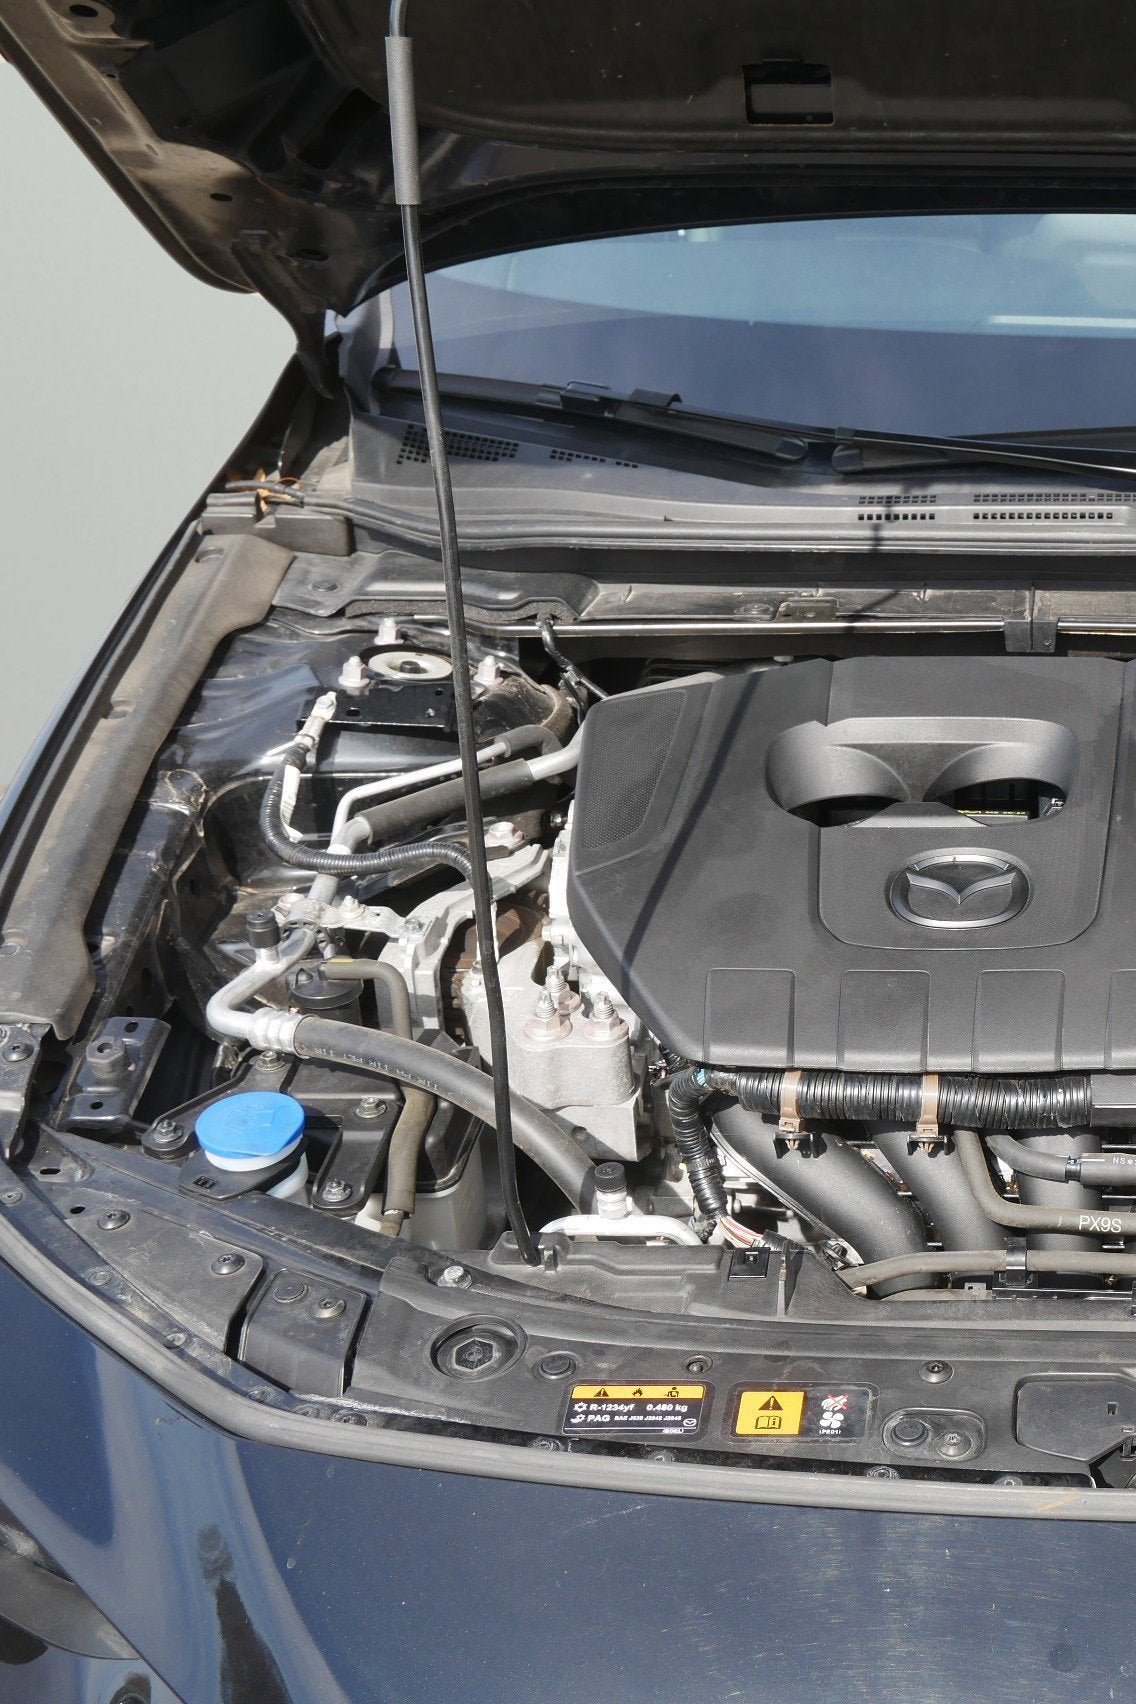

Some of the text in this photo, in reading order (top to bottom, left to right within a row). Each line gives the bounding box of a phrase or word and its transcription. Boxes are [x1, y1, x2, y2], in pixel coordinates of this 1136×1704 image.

[1079, 1214, 1122, 1233] PX9S
[590, 1403, 688, 1412] R-1234yf 0.480 kg
[587, 1414, 611, 1422] PAG
